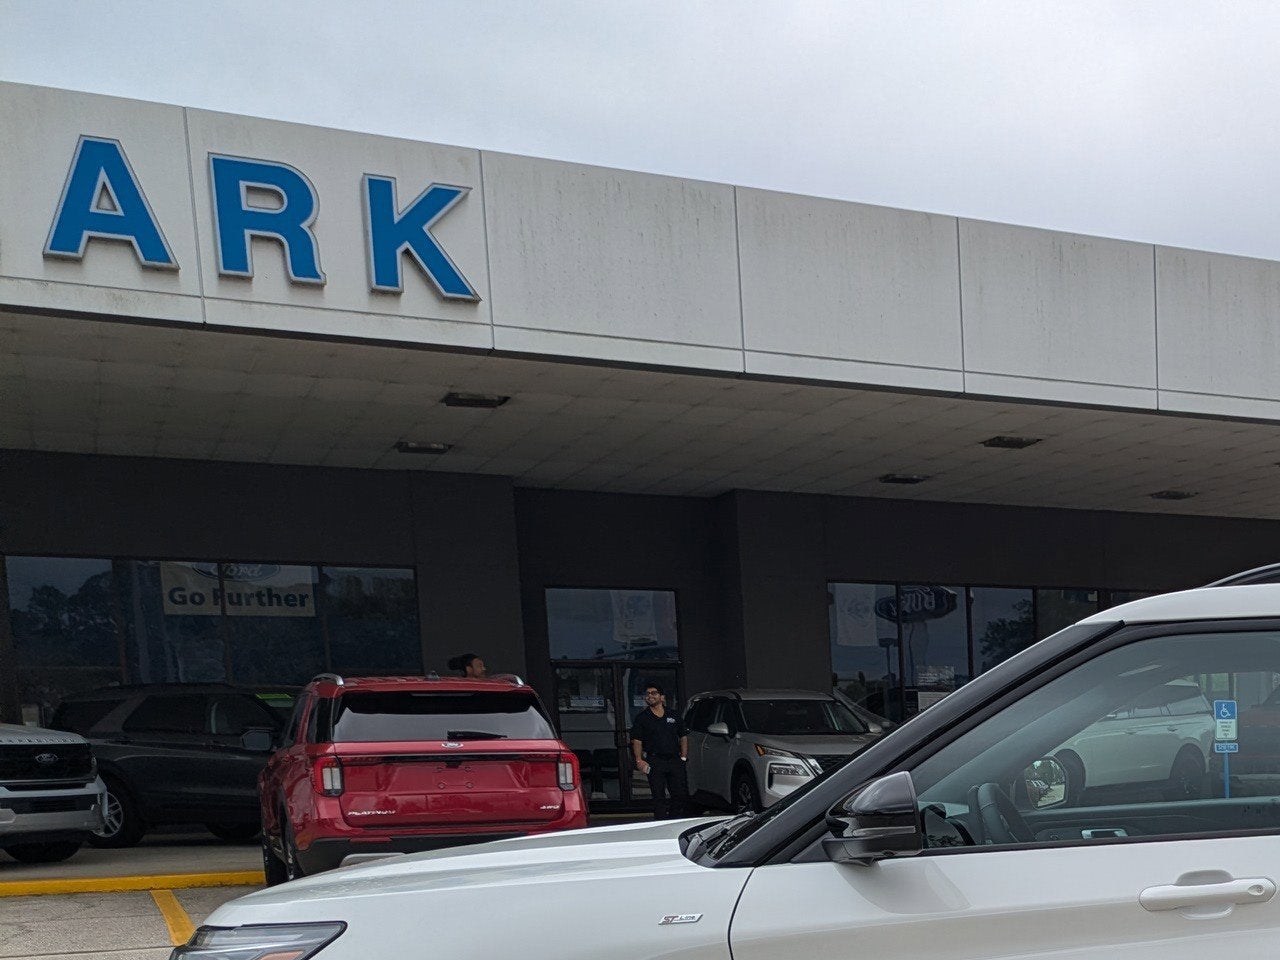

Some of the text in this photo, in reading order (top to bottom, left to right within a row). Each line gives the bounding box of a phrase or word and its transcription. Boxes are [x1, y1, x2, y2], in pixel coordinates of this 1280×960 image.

[43, 134, 482, 302] ARK
[168, 586, 310, 608] Go Further
